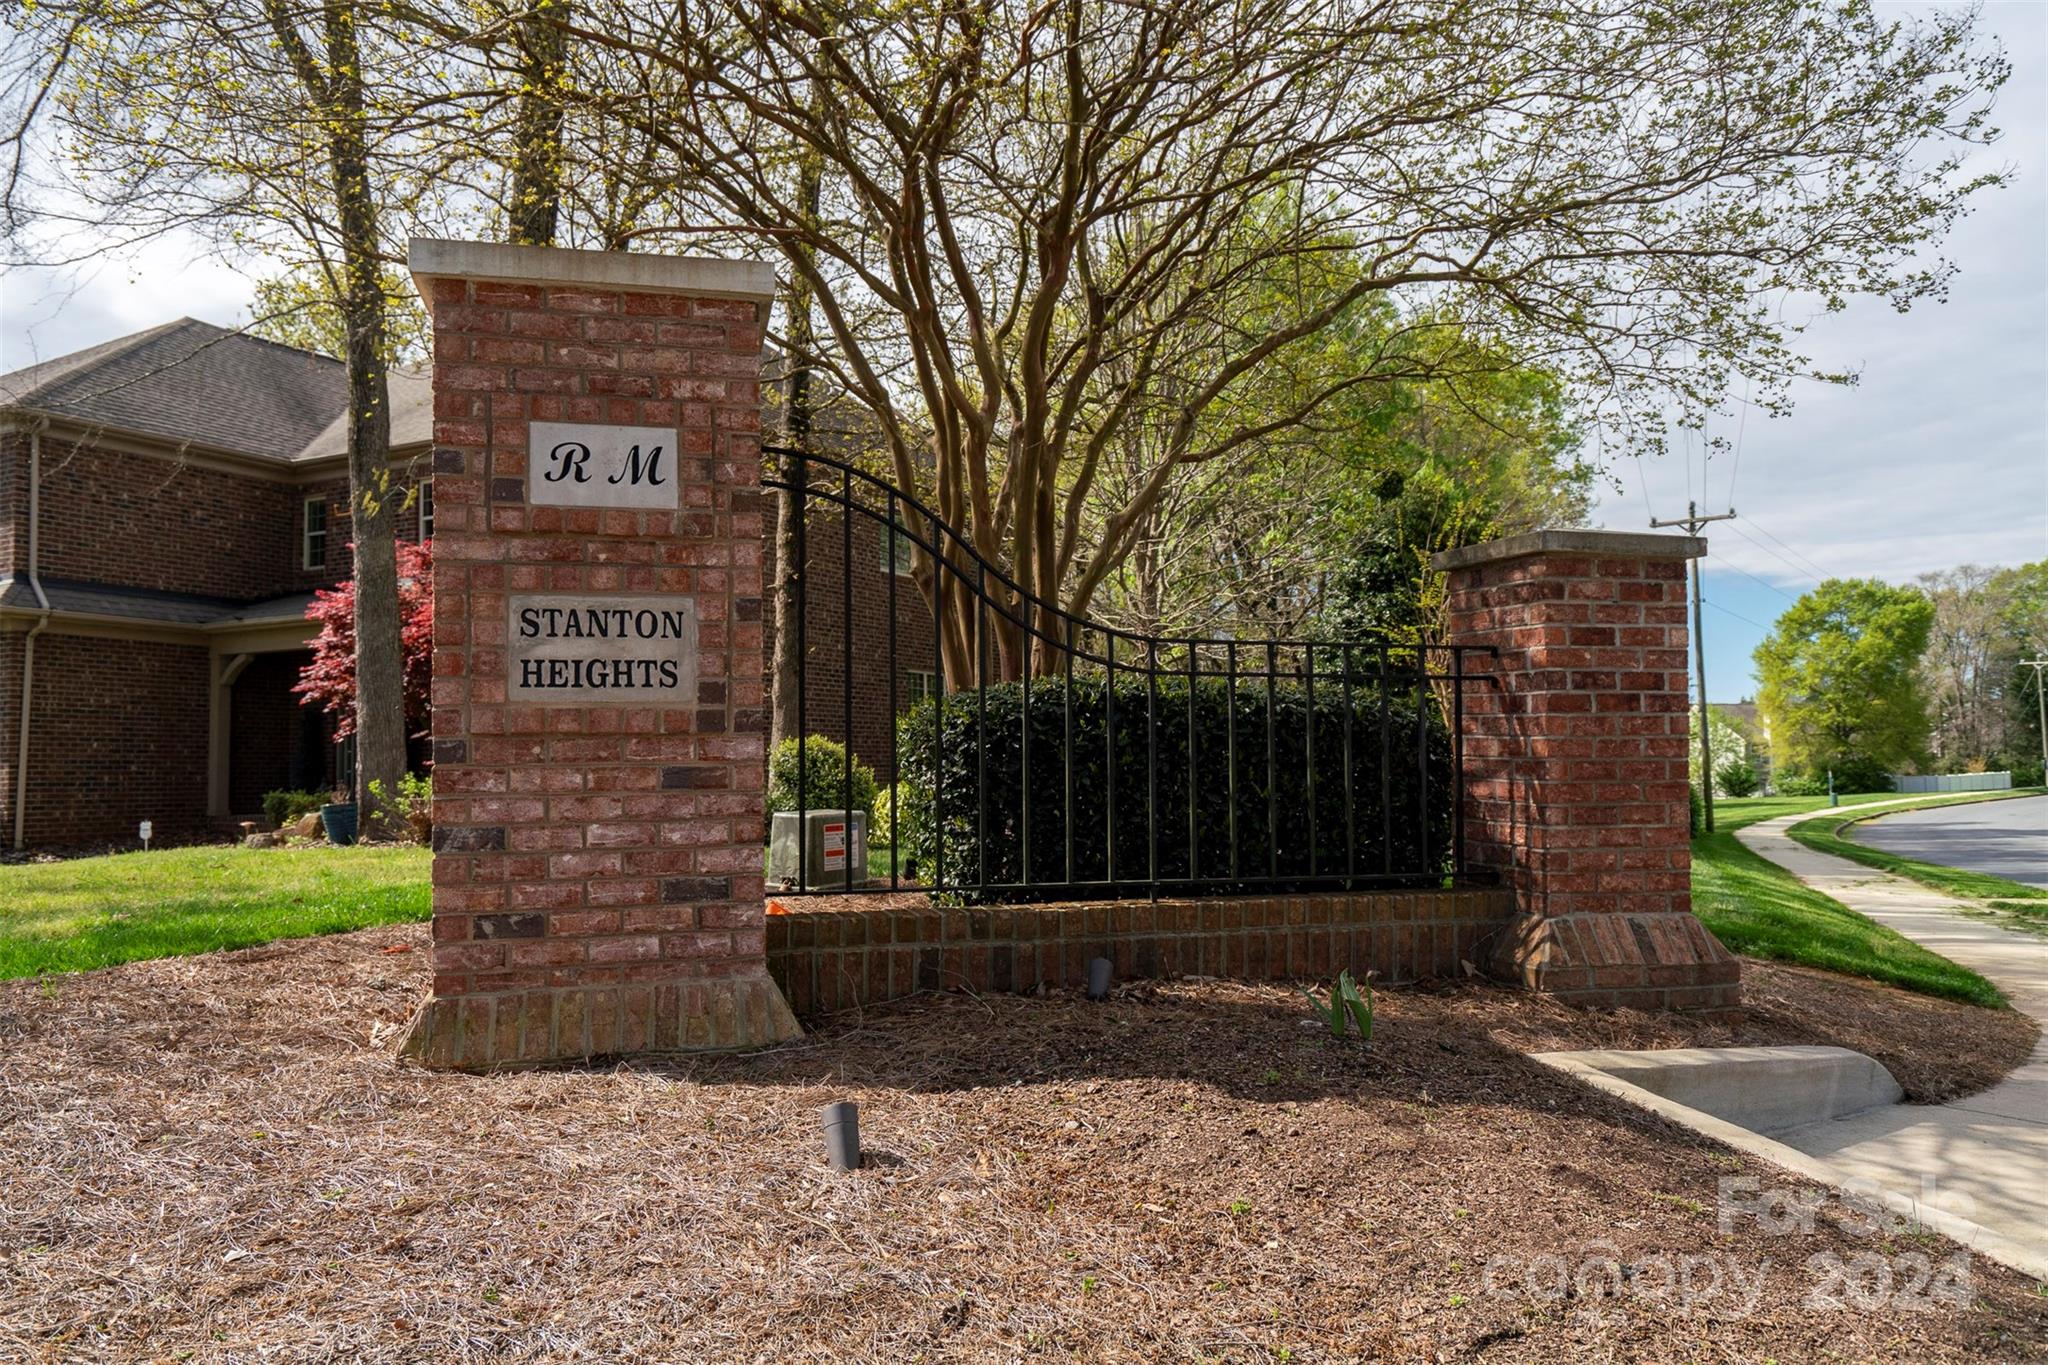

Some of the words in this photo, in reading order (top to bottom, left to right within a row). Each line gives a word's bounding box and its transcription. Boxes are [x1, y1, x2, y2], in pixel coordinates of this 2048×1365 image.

[544, 442, 592, 483] R
[608, 445, 666, 485] M
[519, 608, 684, 638] STANTON
[519, 659, 678, 688] HEIGHTS
